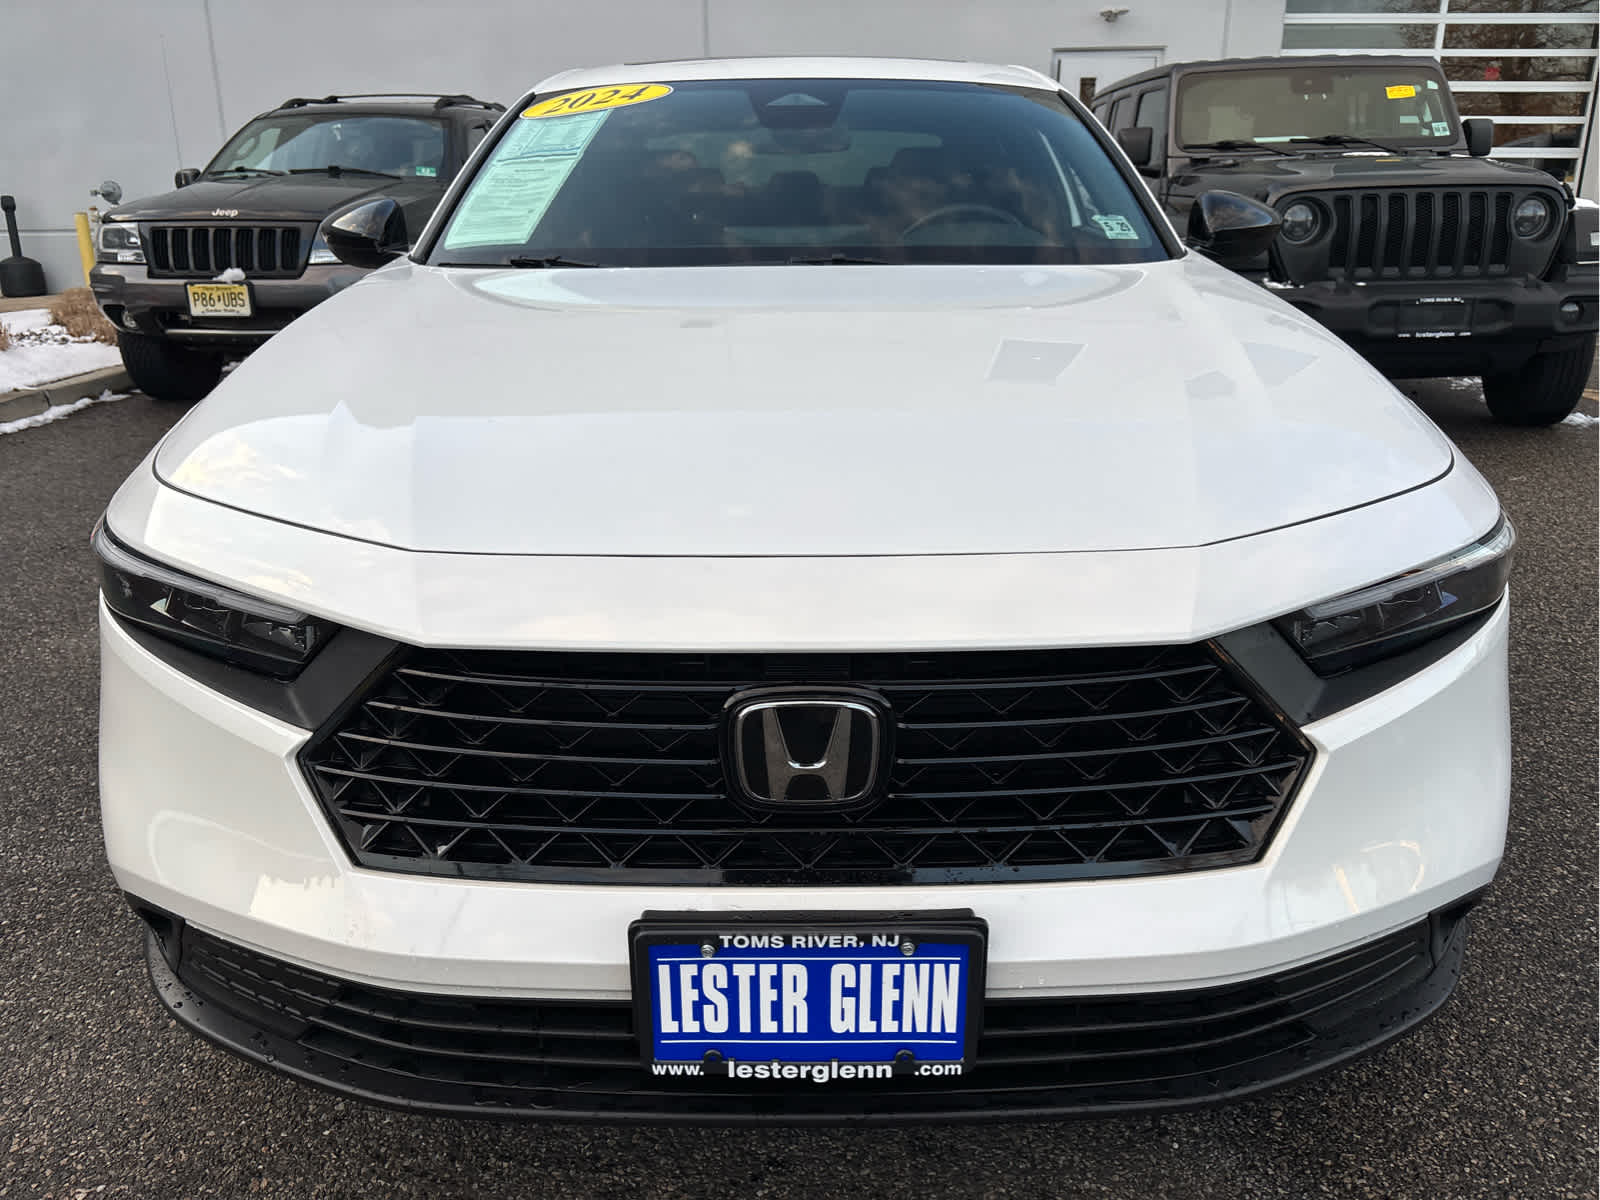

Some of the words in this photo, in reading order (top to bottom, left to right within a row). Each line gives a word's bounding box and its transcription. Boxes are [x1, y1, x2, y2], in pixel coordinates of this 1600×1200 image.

[543, 85, 651, 115] 2024
[211, 208, 239, 218] Jeep
[719, 934, 785, 949] TOMS
[791, 934, 866, 951] RIVER,
[871, 934, 900, 948] NJ
[658, 963, 808, 1034] LESTER
[829, 963, 960, 1034] GLENN
[651, 1063, 705, 1076] www.
[727, 1060, 893, 1083] lesterglenn
[913, 1062, 963, 1076] .com
